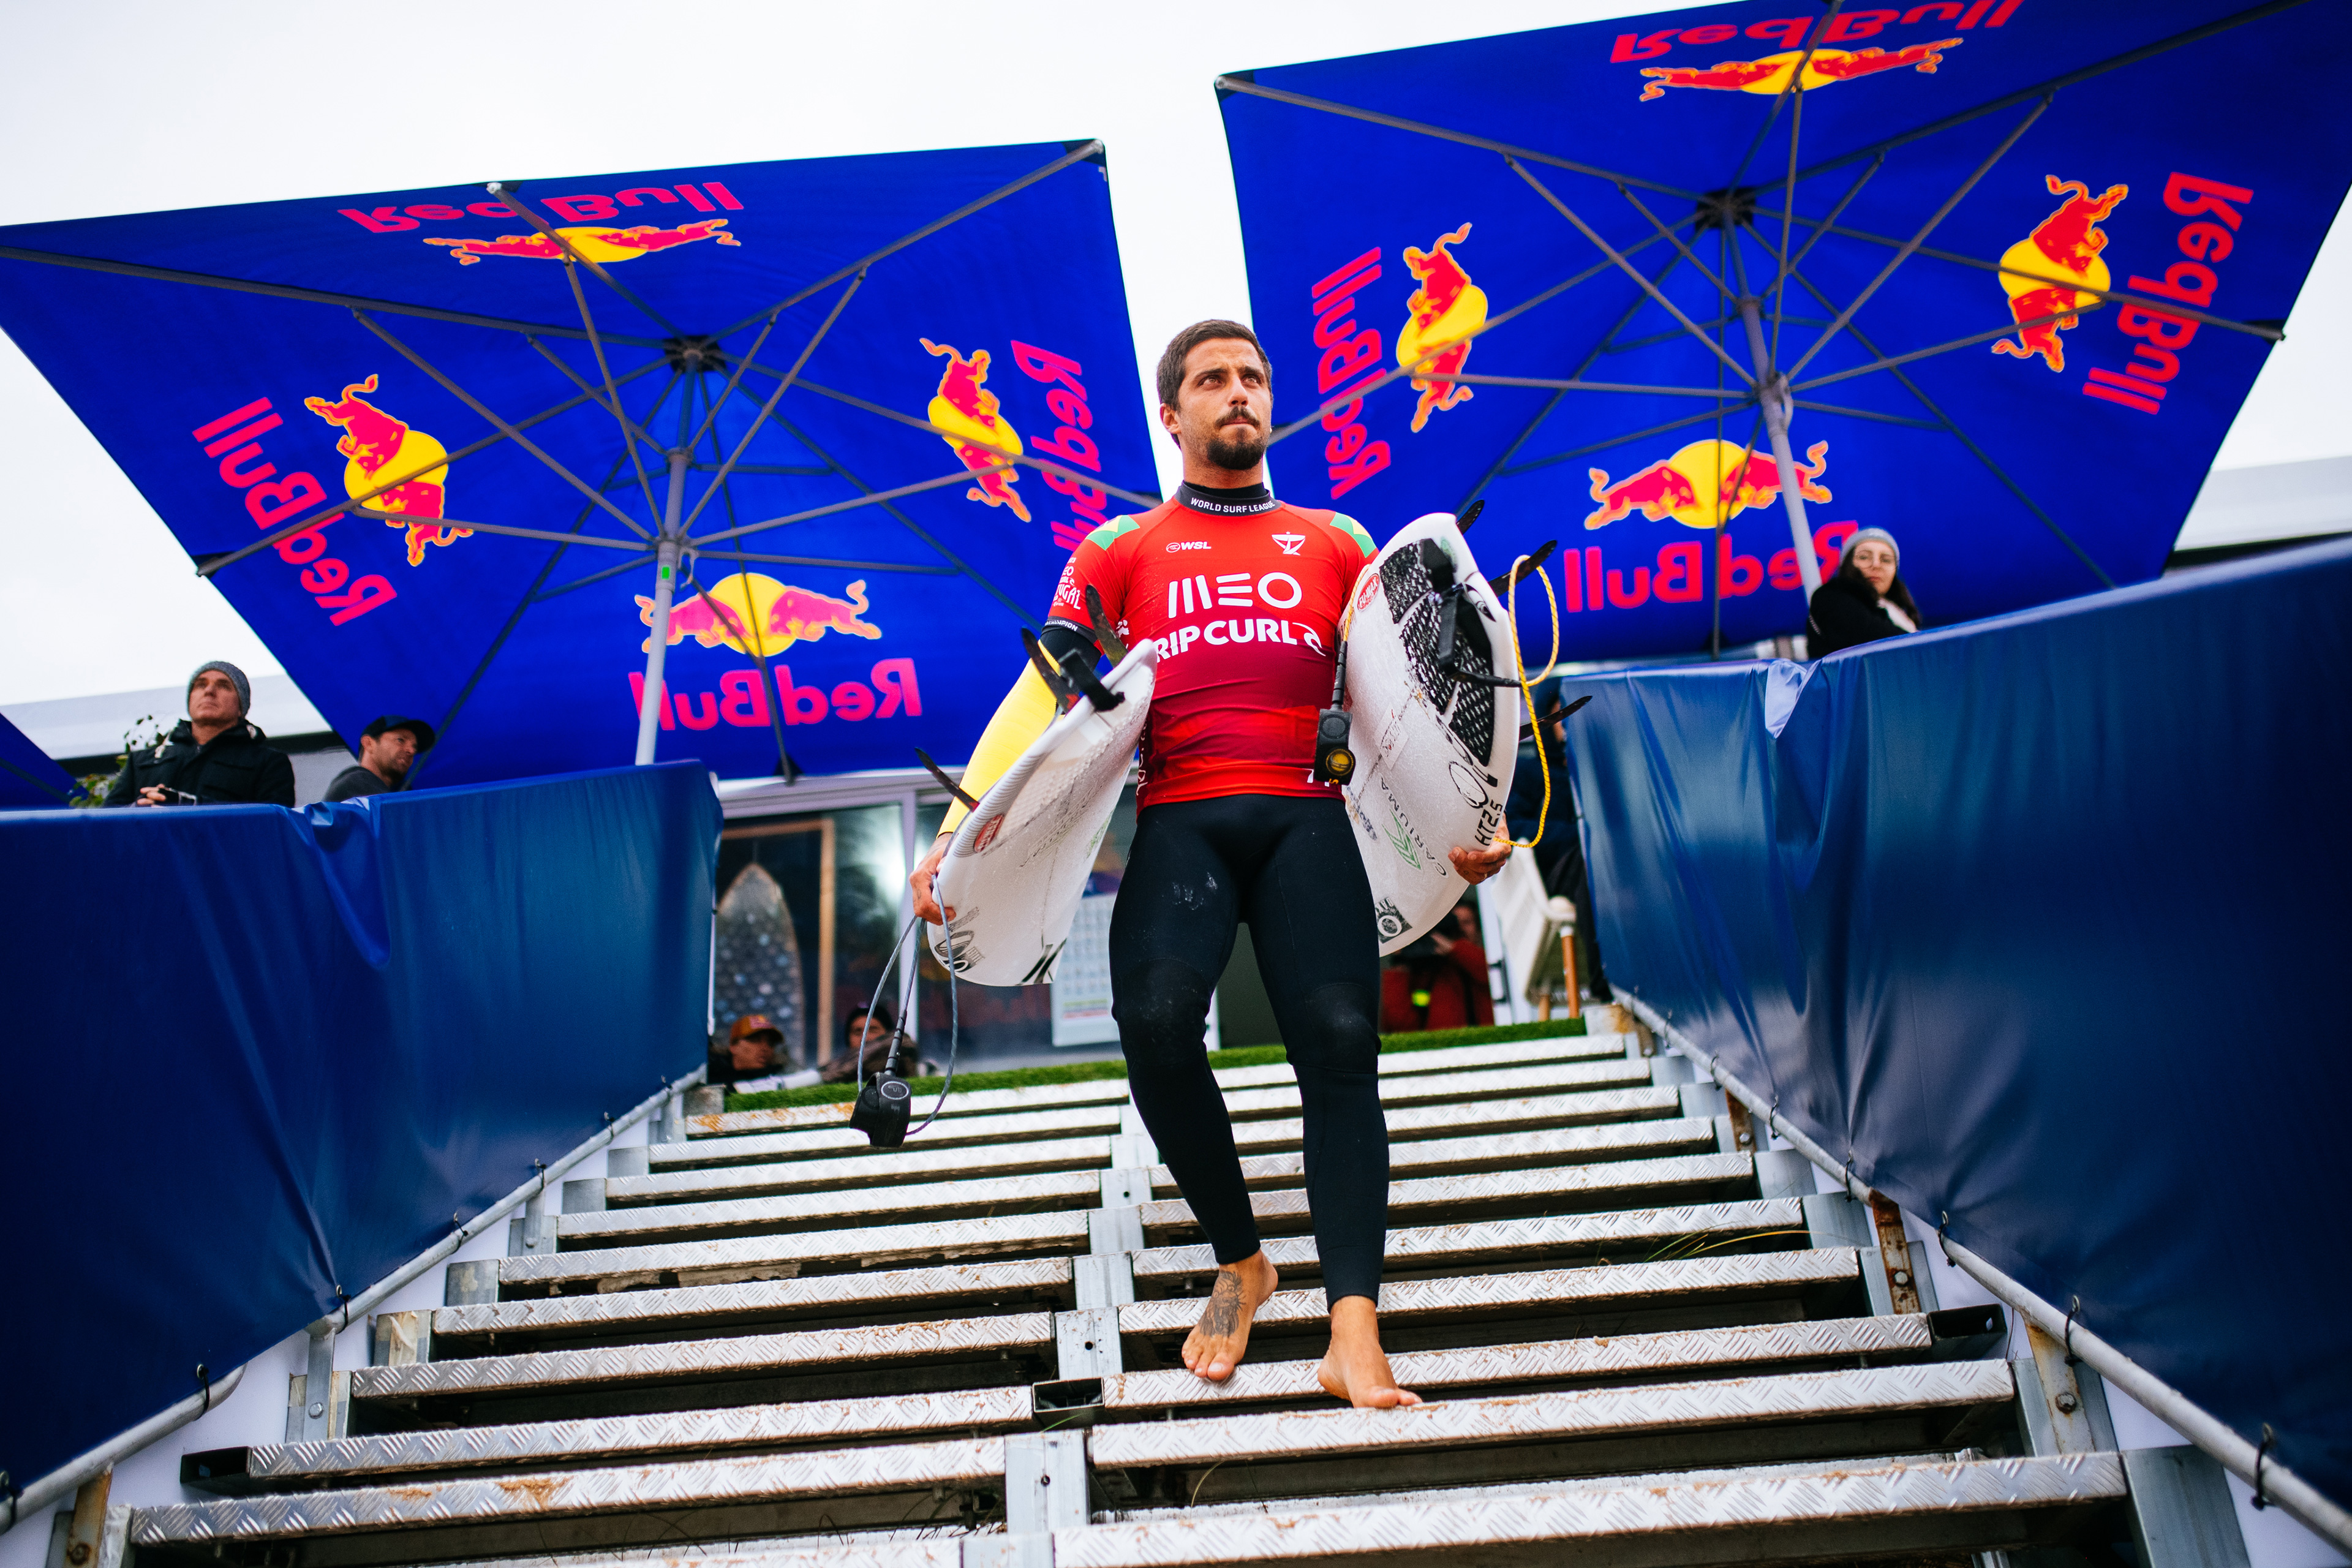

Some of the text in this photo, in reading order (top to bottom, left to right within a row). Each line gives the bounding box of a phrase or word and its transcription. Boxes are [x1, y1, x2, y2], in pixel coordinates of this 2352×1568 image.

[1191, 497, 1276, 513] WORLD SURF LEAGUE
[1180, 541, 1212, 551] WSL
[1168, 571, 1303, 619] MEO
[1153, 625, 1200, 663] RIP
[1204, 619, 1298, 646] CURL
[1381, 776, 1447, 877] CARIUMA
[1474, 799, 1504, 846] HT2.5
